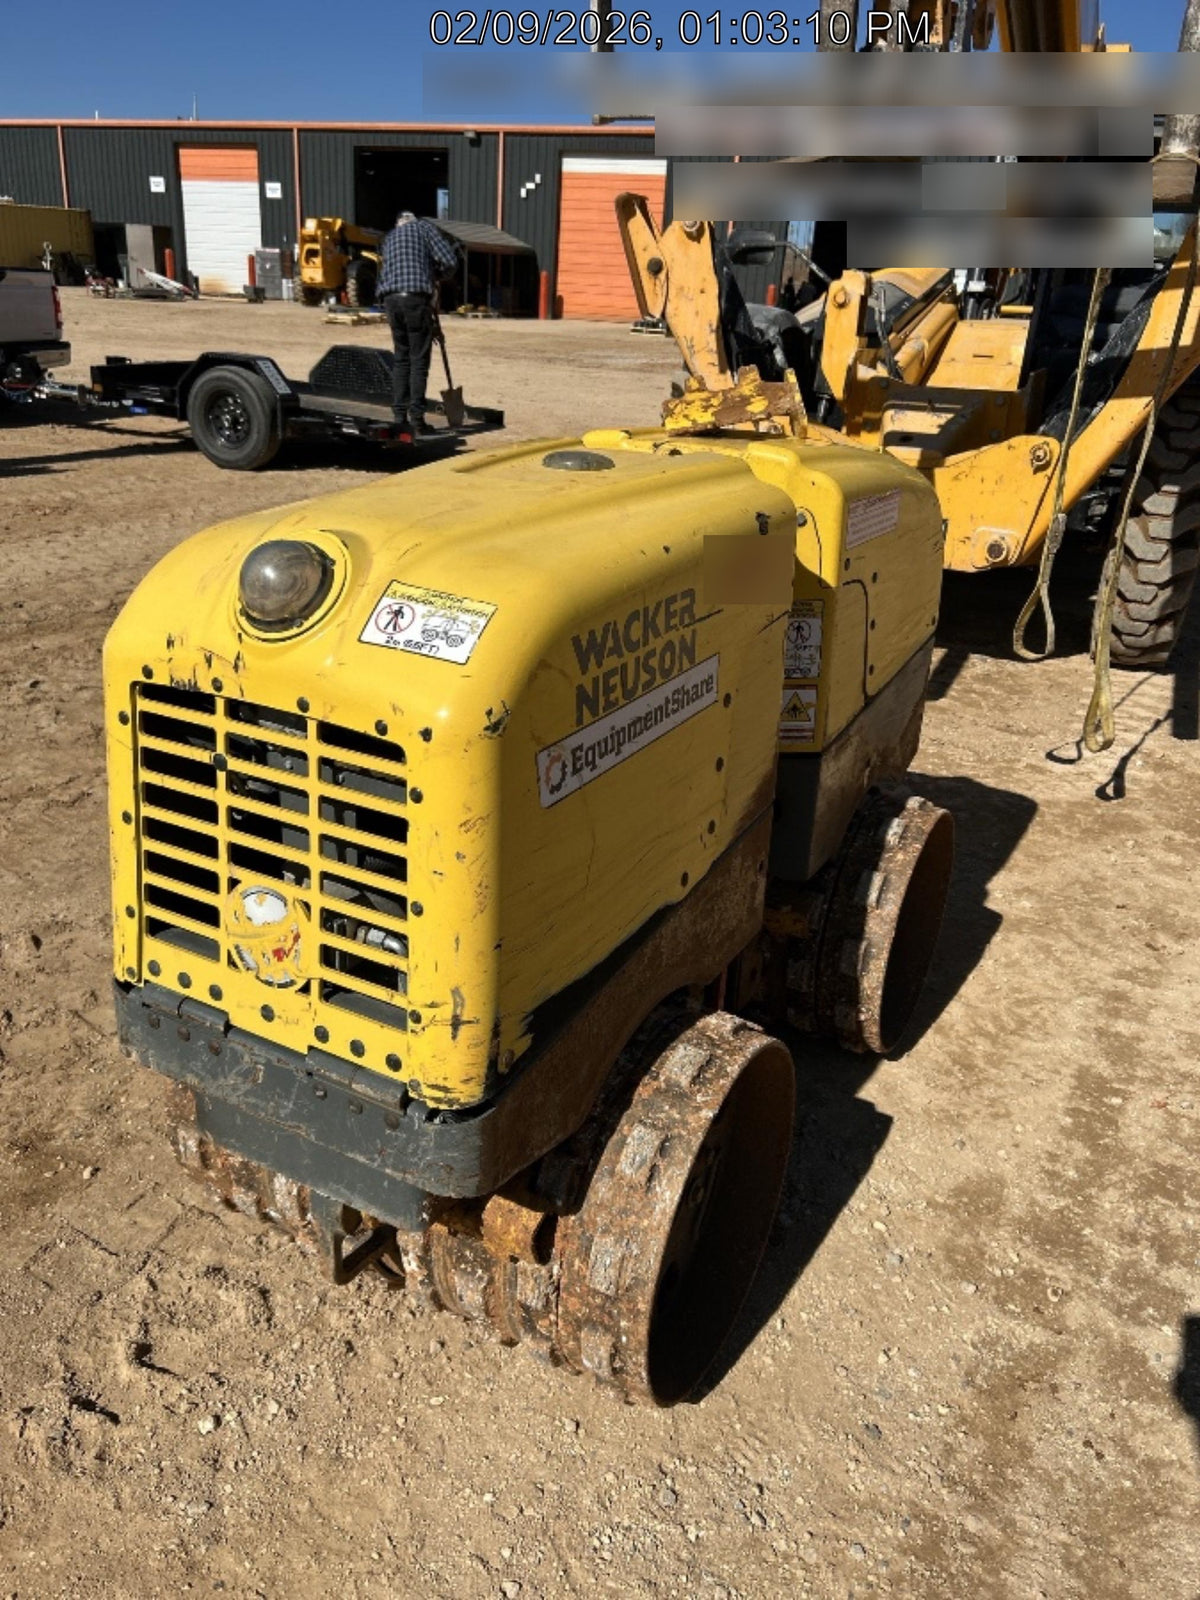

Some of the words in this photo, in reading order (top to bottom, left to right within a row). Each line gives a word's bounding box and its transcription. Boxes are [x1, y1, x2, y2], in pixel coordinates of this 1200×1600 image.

[571, 587, 697, 676] WACKER
[575, 629, 697, 727] NEUSON
[570, 672, 714, 777] EquipmentShare
